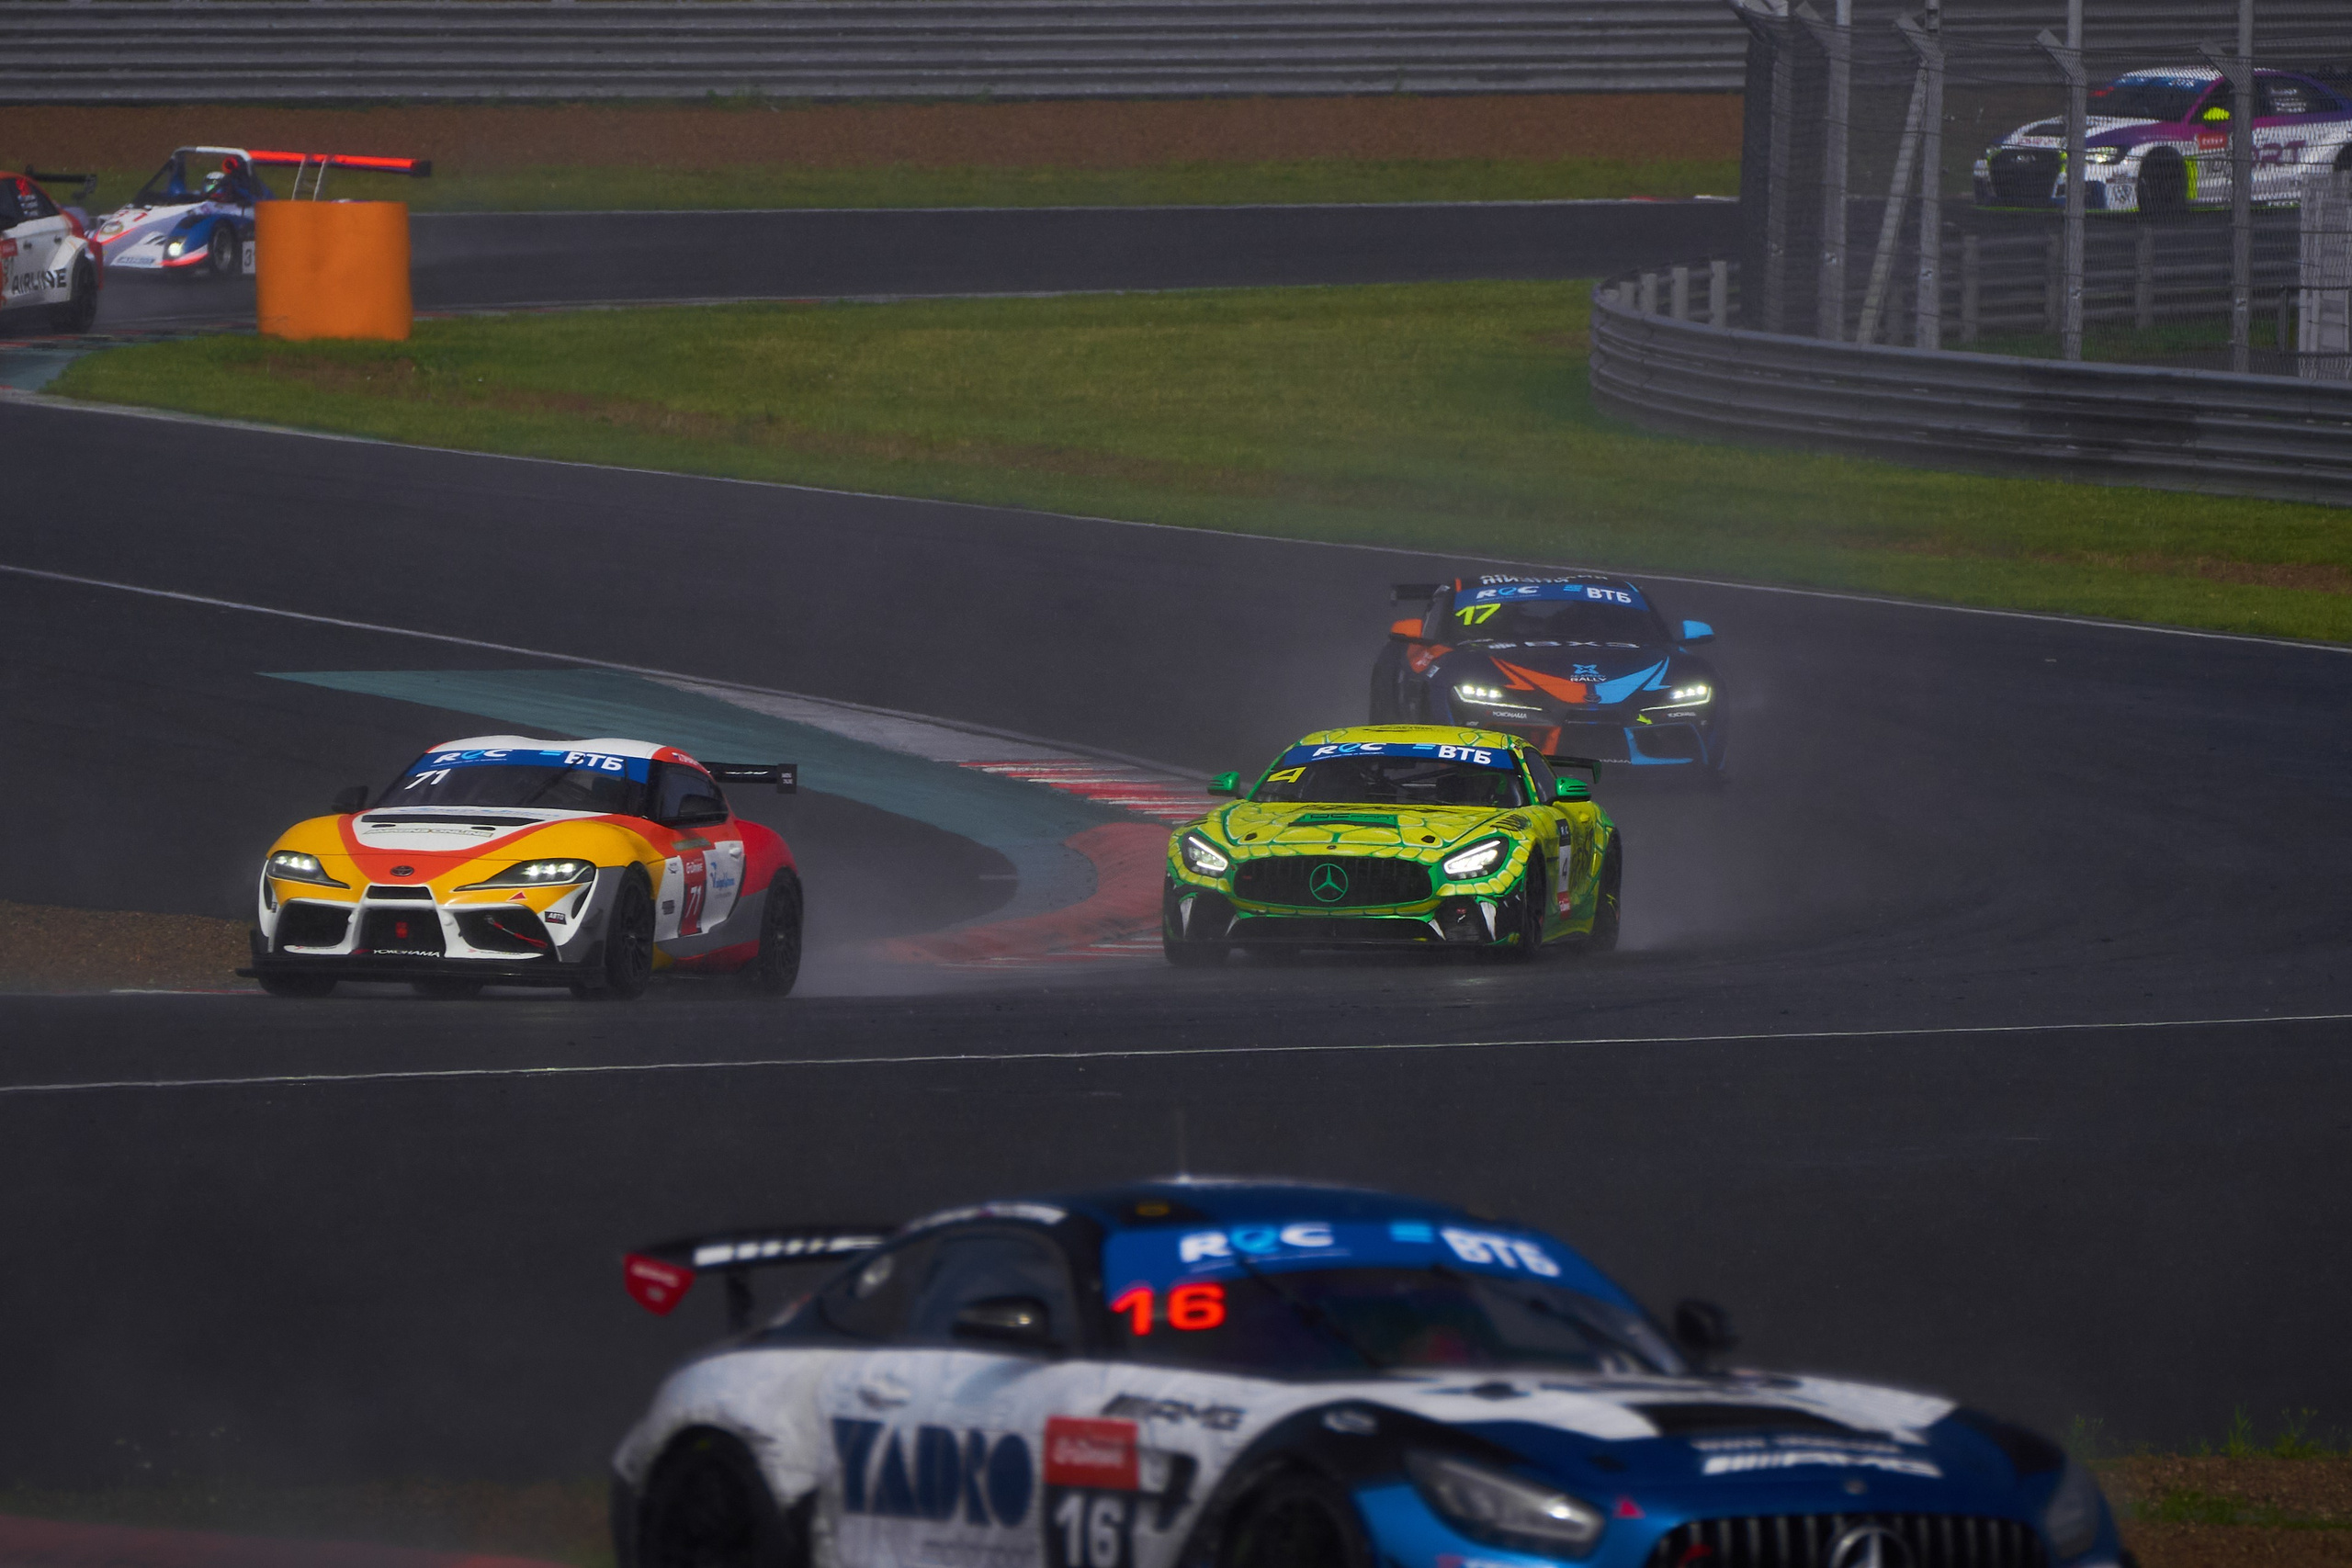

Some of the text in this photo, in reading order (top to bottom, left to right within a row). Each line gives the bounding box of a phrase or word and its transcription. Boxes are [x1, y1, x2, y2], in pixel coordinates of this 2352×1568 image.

[11, 268, 67, 295] AIRLINE
[1587, 587, 1632, 604] ВТБ
[1455, 603, 1501, 626] 17
[563, 751, 625, 771] ВТБ
[1438, 745, 1492, 765] ВТБ
[404, 769, 452, 790] 71
[1267, 766, 1306, 784] 4
[685, 886, 702, 919] 71
[372, 949, 440, 958] YOKOHAMA
[1440, 1227, 1561, 1277] ВТБ
[1111, 1281, 1227, 1336] 16
[1055, 1493, 1122, 1567] 16
